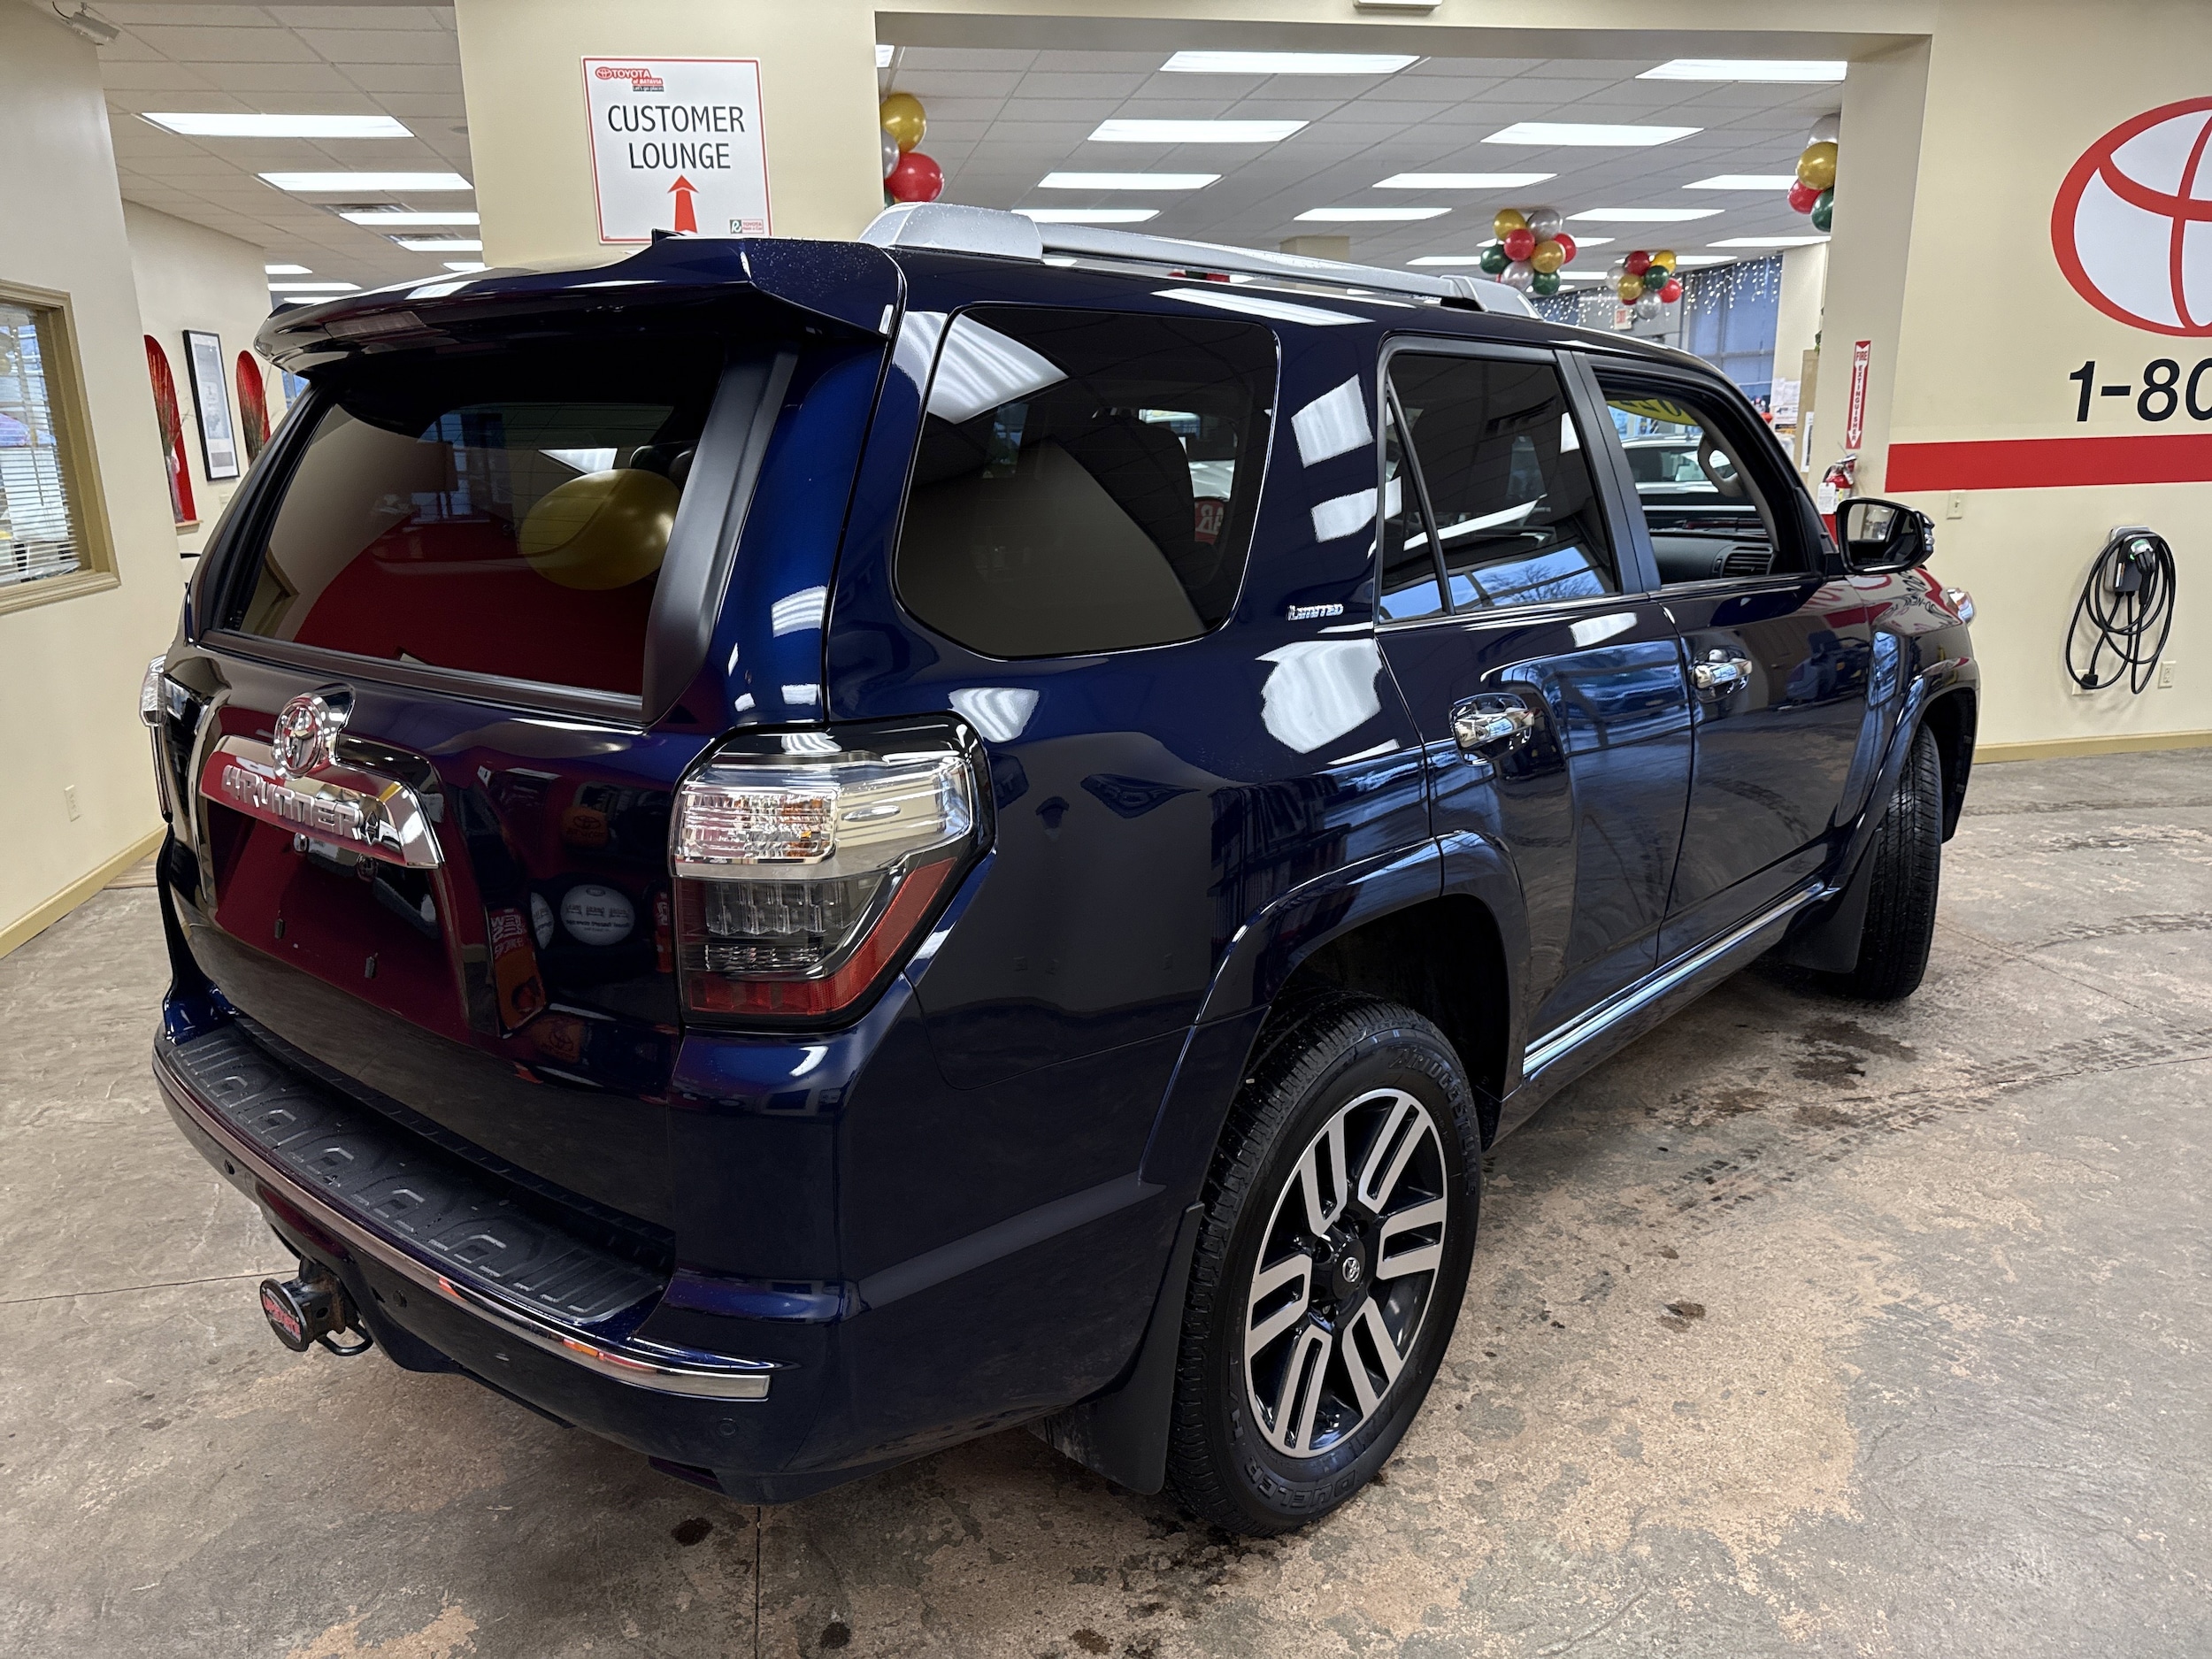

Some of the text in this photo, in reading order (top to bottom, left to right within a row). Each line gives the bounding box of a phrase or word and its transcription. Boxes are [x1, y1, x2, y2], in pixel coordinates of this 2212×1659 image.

[611, 69, 651, 79] TOYOTA
[608, 104, 745, 132] CUSTOMER
[628, 142, 731, 169] LOUNGE
[1855, 351, 1868, 361] FIRE
[1852, 365, 1863, 441] EXTINGUISHER
[1287, 603, 1344, 620] LIMITED
[222, 764, 364, 840] 4RUNNER
[1244, 1456, 1356, 1509] DUELER
